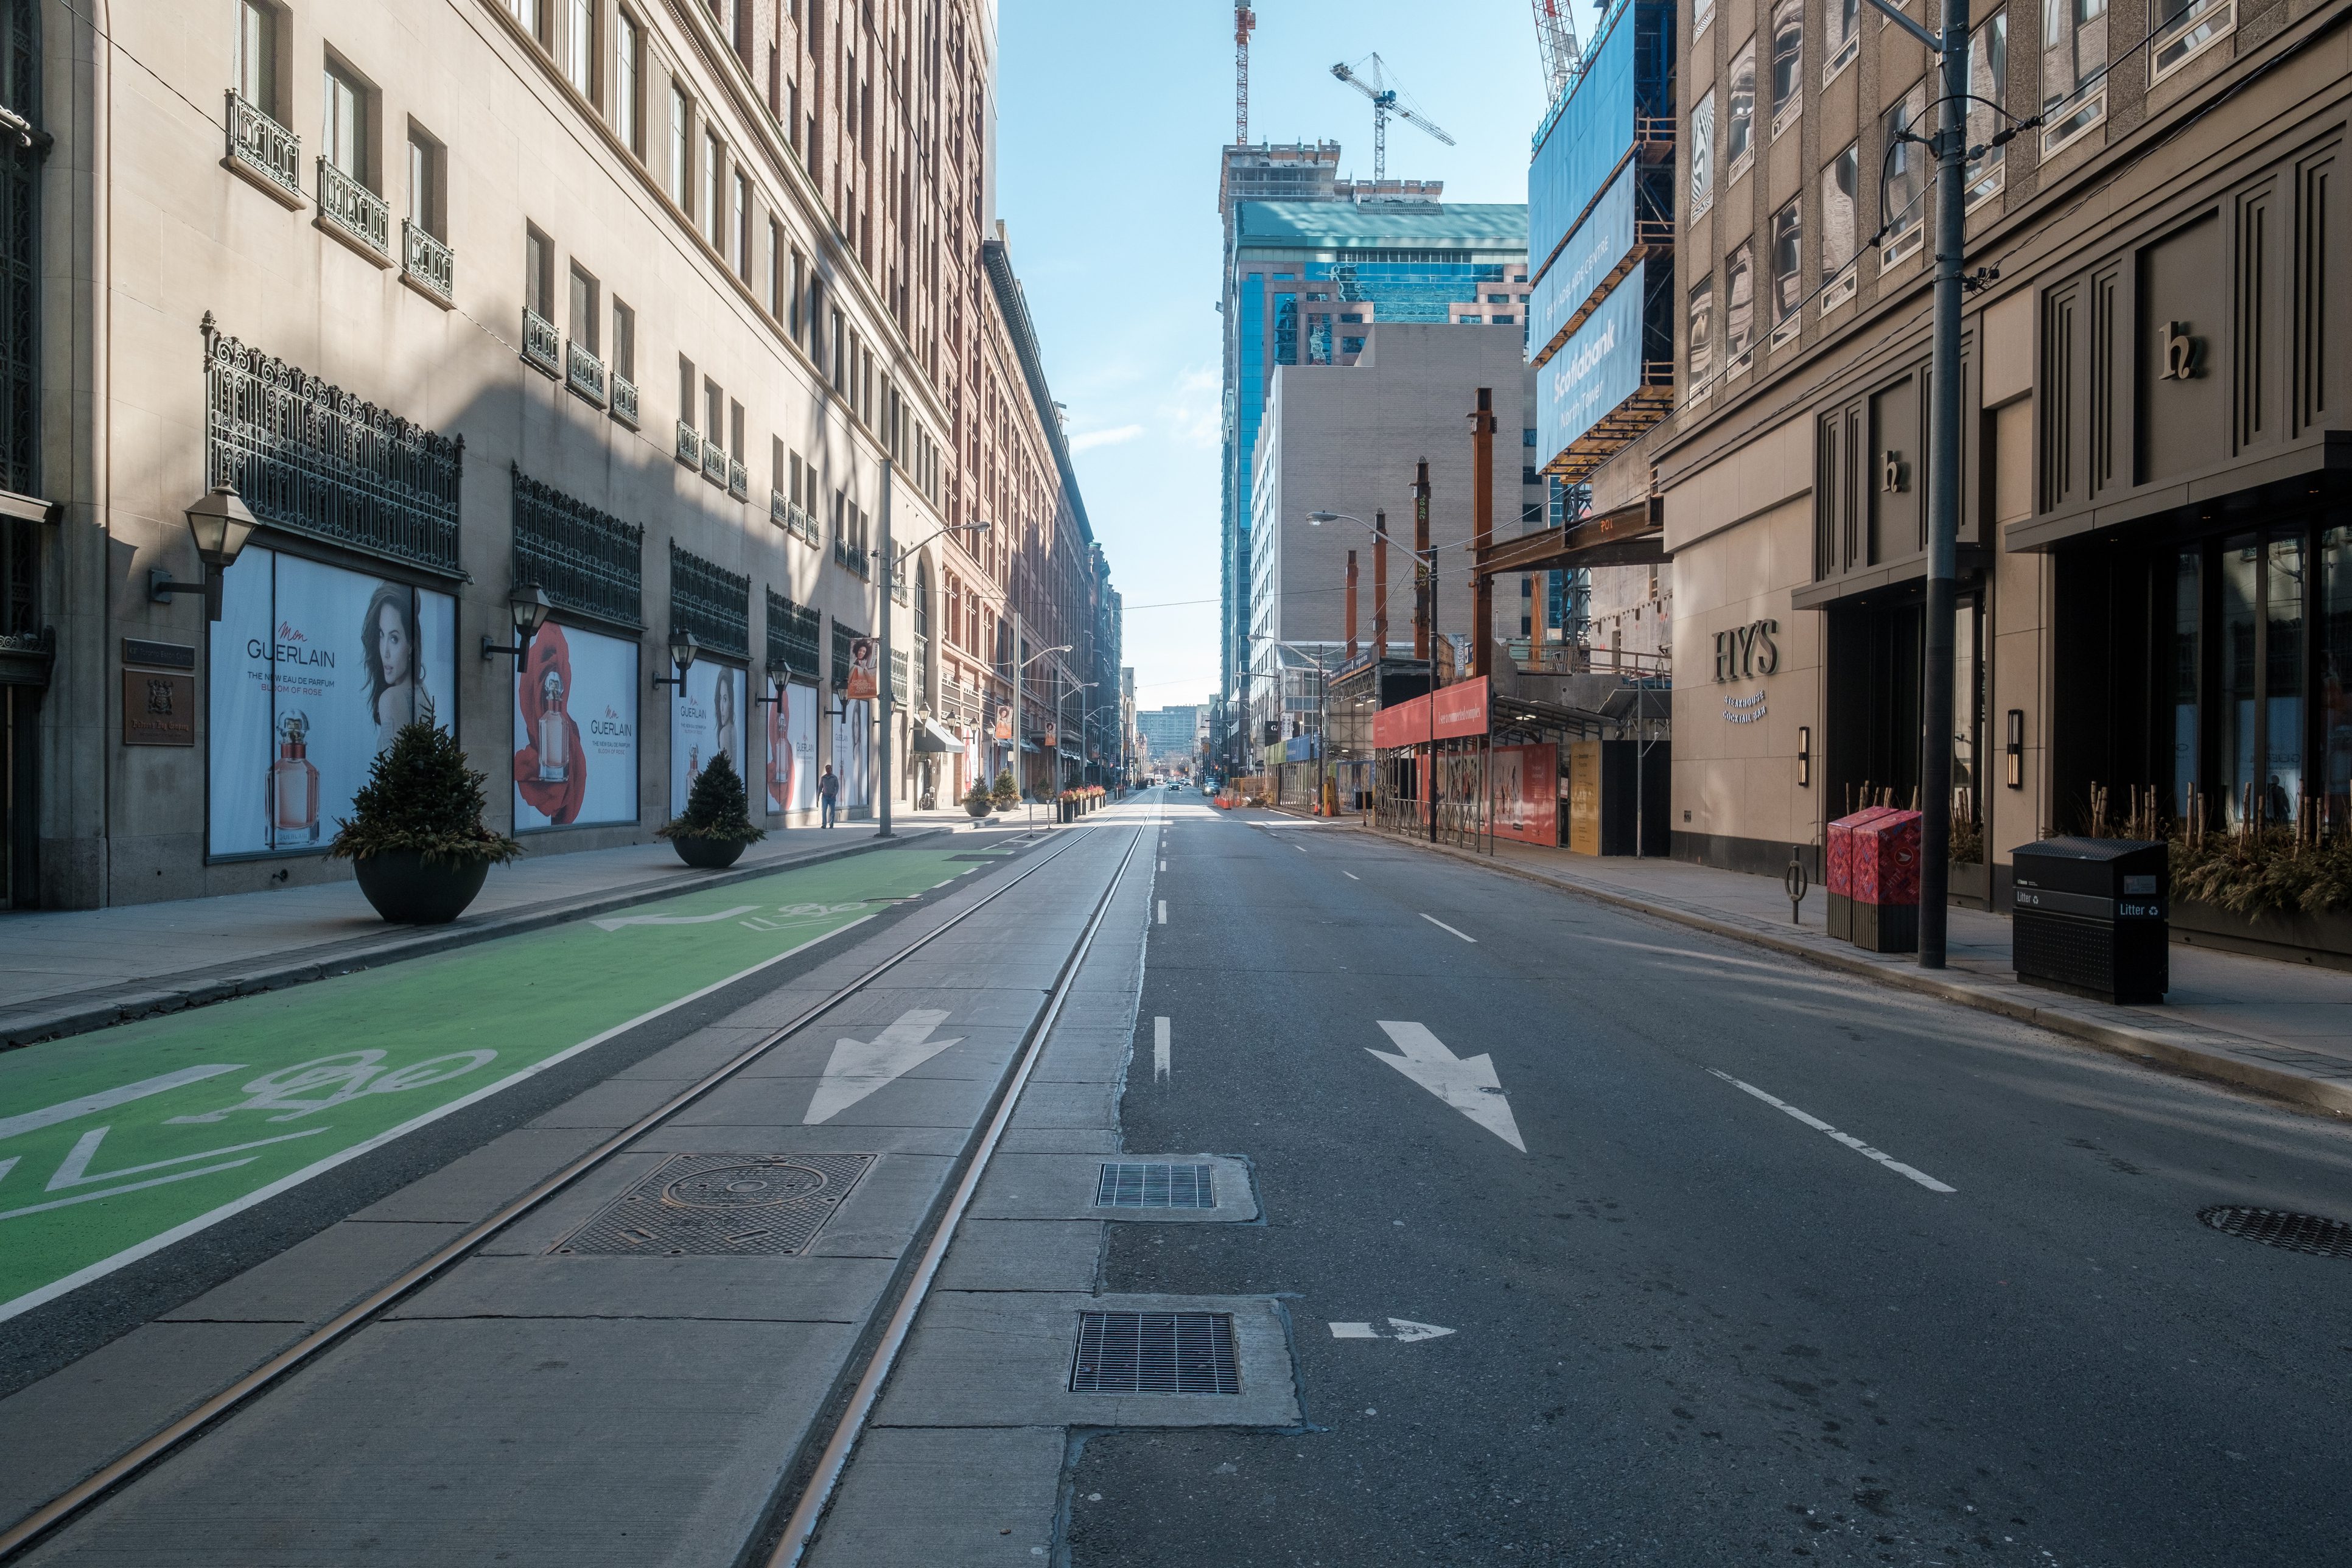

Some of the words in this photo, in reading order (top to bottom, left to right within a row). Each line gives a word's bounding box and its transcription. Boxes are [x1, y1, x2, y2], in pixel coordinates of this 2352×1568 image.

[1546, 299, 1557, 321] BAY
[1558, 265, 1583, 308] ADELAIDE
[1584, 235, 1608, 274] CENTRE
[1554, 318, 1615, 404] Scotiabank
[1561, 399, 1580, 430] North
[1581, 380, 1603, 411] Tower
[278, 621, 308, 642] Mon
[247, 639, 335, 668] GUERLAIN
[248, 671, 263, 680] THE
[283, 675, 297, 684] EAU
[309, 678, 335, 687] PARFUM
[1724, 689, 1765, 709] STEAKHOUSE
[681, 706, 707, 719] GUERLAIN
[1466, 703, 1481, 723] complex
[1723, 710, 1752, 724] COCKTAIL
[1753, 705, 1767, 721] BAR
[591, 719, 632, 737] GUERLAIN
[2017, 891, 2031, 903] Litter
[2121, 904, 2144, 915] Litter
